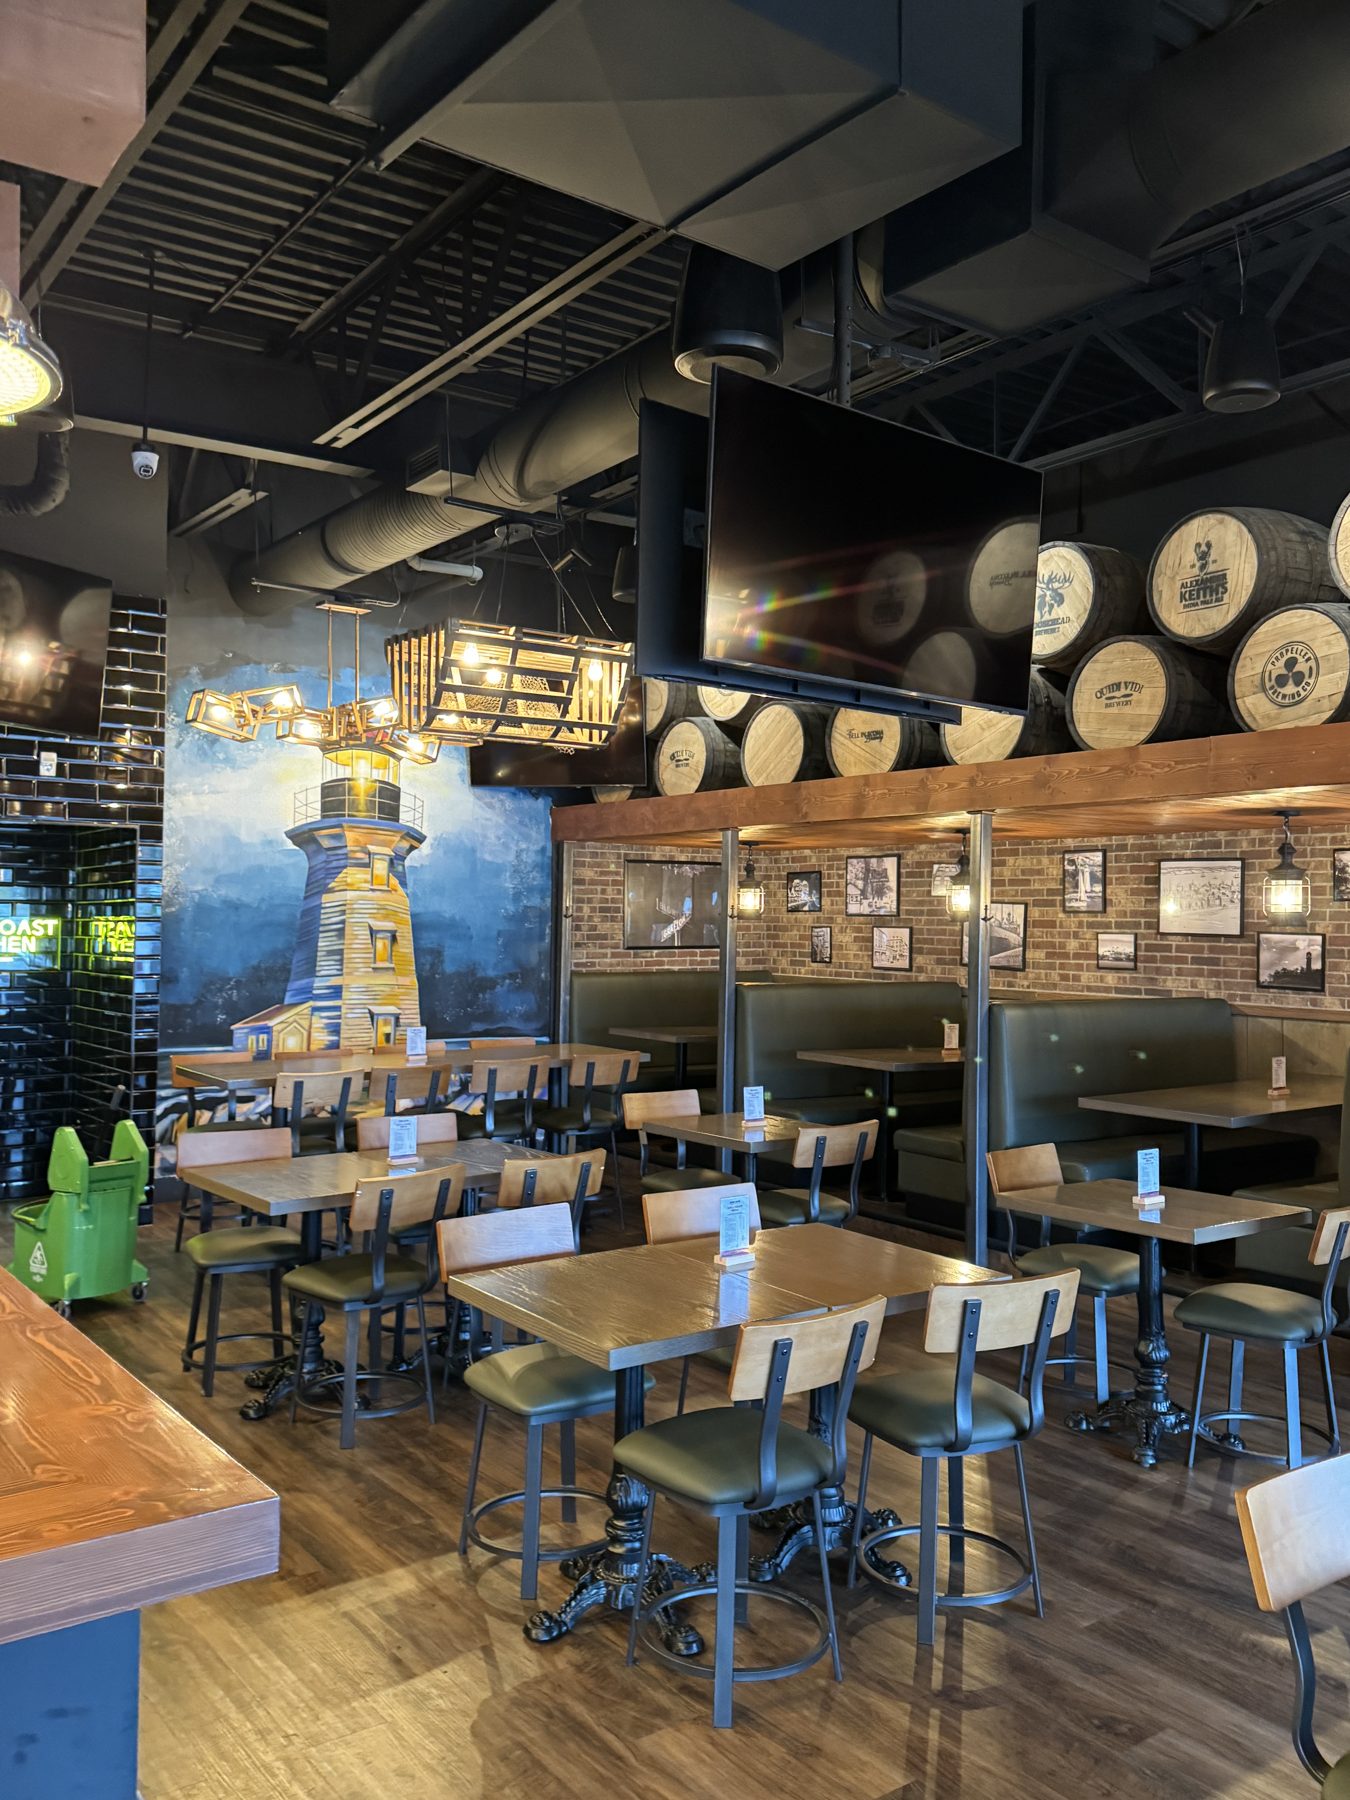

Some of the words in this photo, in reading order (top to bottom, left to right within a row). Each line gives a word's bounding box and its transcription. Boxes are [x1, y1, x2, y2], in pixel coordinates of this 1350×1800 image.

[1180, 573, 1227, 589] ALEXANDER
[1271, 647, 1312, 667] PROPELLER
[1095, 681, 1121, 699] QUIDI
[1123, 681, 1144, 694] VIDI
[1269, 684, 1301, 701] BREWING
[1104, 700, 1132, 709] BREWERY
